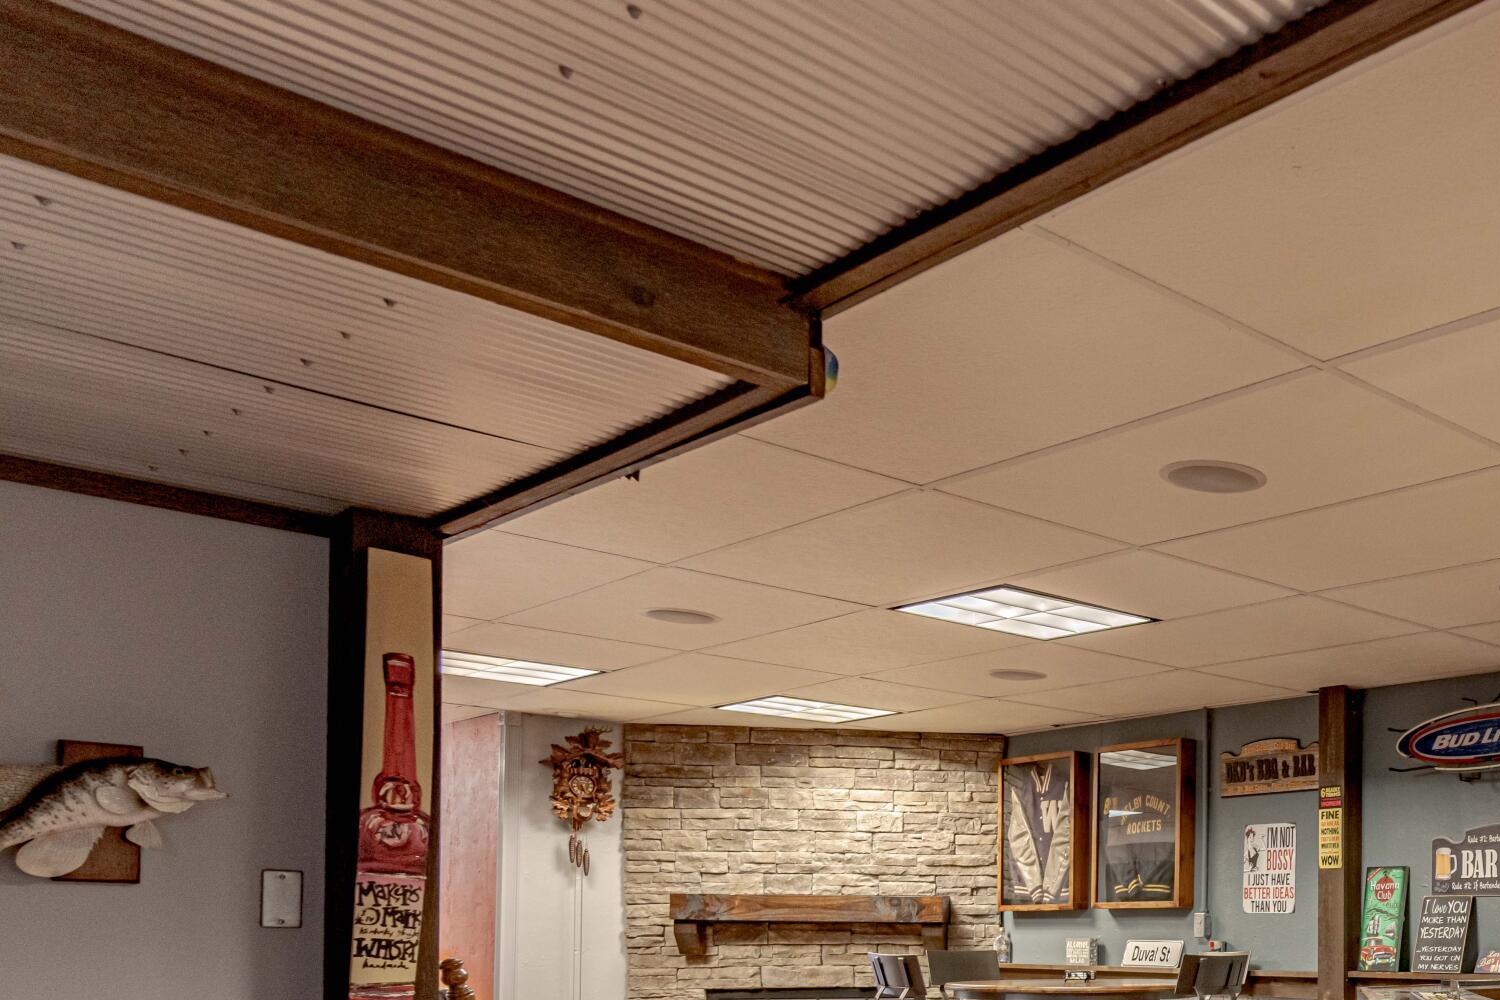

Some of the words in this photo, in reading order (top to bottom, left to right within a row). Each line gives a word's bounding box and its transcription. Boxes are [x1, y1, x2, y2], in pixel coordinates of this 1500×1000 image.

[1432, 732, 1481, 750] BUD
[1321, 811, 1340, 820] FINE
[1127, 819, 1162, 835] ROCKETS
[1267, 827, 1278, 849] I'M
[1280, 826, 1295, 849] NOT
[1267, 849, 1294, 871] BOSSY
[1321, 855, 1340, 866] WOW
[1460, 849, 1498, 879] BAR
[1252, 873, 1269, 886] JUST
[1271, 873, 1290, 886] HAVE
[1370, 881, 1400, 891] Havana
[1244, 887, 1271, 900] BETTER
[1272, 886, 1294, 900] IDEAS
[1377, 890, 1392, 900] Club
[1251, 900, 1271, 913] THAN
[1273, 900, 1287, 913] YOU
[1423, 899, 1431, 915] I
[1432, 898, 1449, 915] love
[1448, 901, 1468, 914] YOU
[1421, 916, 1445, 924] MORE
[1446, 915, 1468, 924] THAN
[1419, 926, 1466, 940] YESTERDAY
[1132, 945, 1158, 962] Duval
[1159, 946, 1171, 962] St
[1434, 954, 1449, 962] GOT
[1450, 954, 1462, 962] ON
[1417, 963, 1430, 971] MY
[1431, 962, 1460, 971] NERVES
